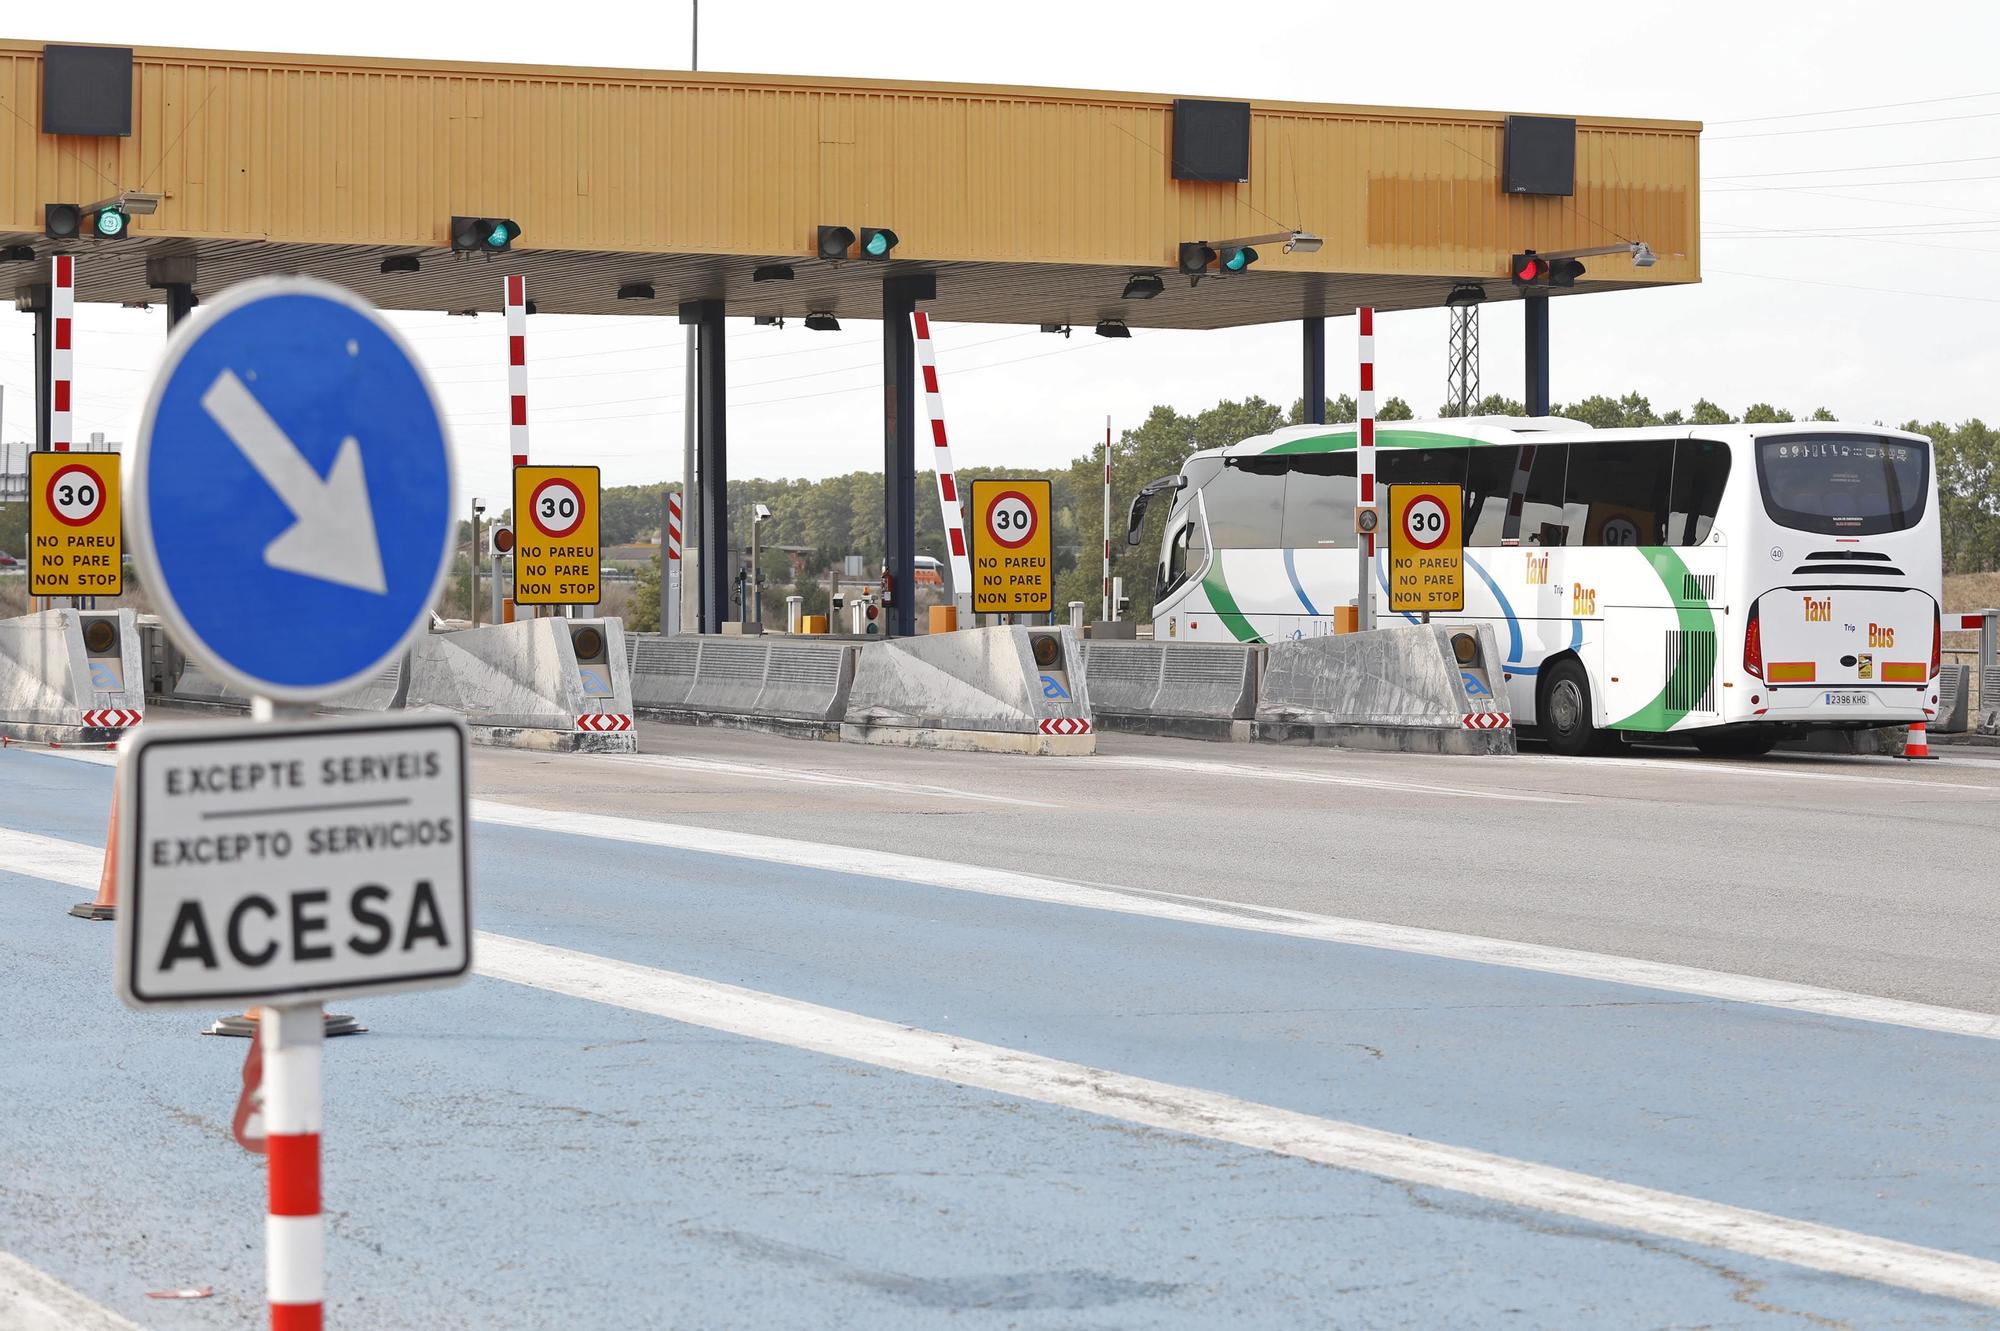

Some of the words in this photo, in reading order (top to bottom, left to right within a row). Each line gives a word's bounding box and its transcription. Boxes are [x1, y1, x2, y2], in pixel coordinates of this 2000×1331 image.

[58, 485, 95, 506] 30
[541, 498, 575, 518] 30
[997, 510, 1028, 530] 30
[1412, 513, 1441, 532] 30
[37, 536, 59, 547] NO
[67, 536, 115, 547] PAREU
[521, 547, 542, 558] NO
[549, 547, 594, 558] PAREU
[1772, 549, 1782, 558] 40
[42, 555, 64, 566] NO
[73, 555, 110, 566] PARE
[978, 558, 998, 568] NO
[1005, 557, 1046, 568] PAREU
[1395, 558, 1413, 568] NO
[1419, 558, 1458, 568] PAREU
[526, 565, 547, 576] NO
[554, 565, 589, 576] PARE
[1526, 552, 1549, 585] Taxi
[35, 574, 69, 585] NON
[78, 574, 117, 585] STOP
[983, 575, 1002, 586] NO
[1009, 575, 1042, 585] PARE
[1400, 575, 1417, 585] NO
[1424, 575, 1454, 585] PARE
[520, 584, 551, 595] NON
[559, 584, 595, 594] STOP
[1553, 584, 1564, 595] Trip
[978, 593, 1006, 603] NON
[1014, 592, 1048, 603] STOP
[1394, 592, 1421, 602] NON
[1428, 592, 1459, 602] STOP
[1573, 582, 1596, 616] Bus
[1803, 597, 1831, 622] Taxi
[1844, 623, 1856, 632] Trip
[1868, 622, 1895, 648] Bus
[1831, 695, 1851, 704] 2396
[1852, 695, 1867, 704] KHG
[165, 760, 305, 796] EXCEPTE
[321, 751, 441, 785] SERVEIS
[152, 831, 292, 867] EXCEPTO
[308, 818, 454, 856] SERVICIOS
[157, 880, 450, 973] ACESA
